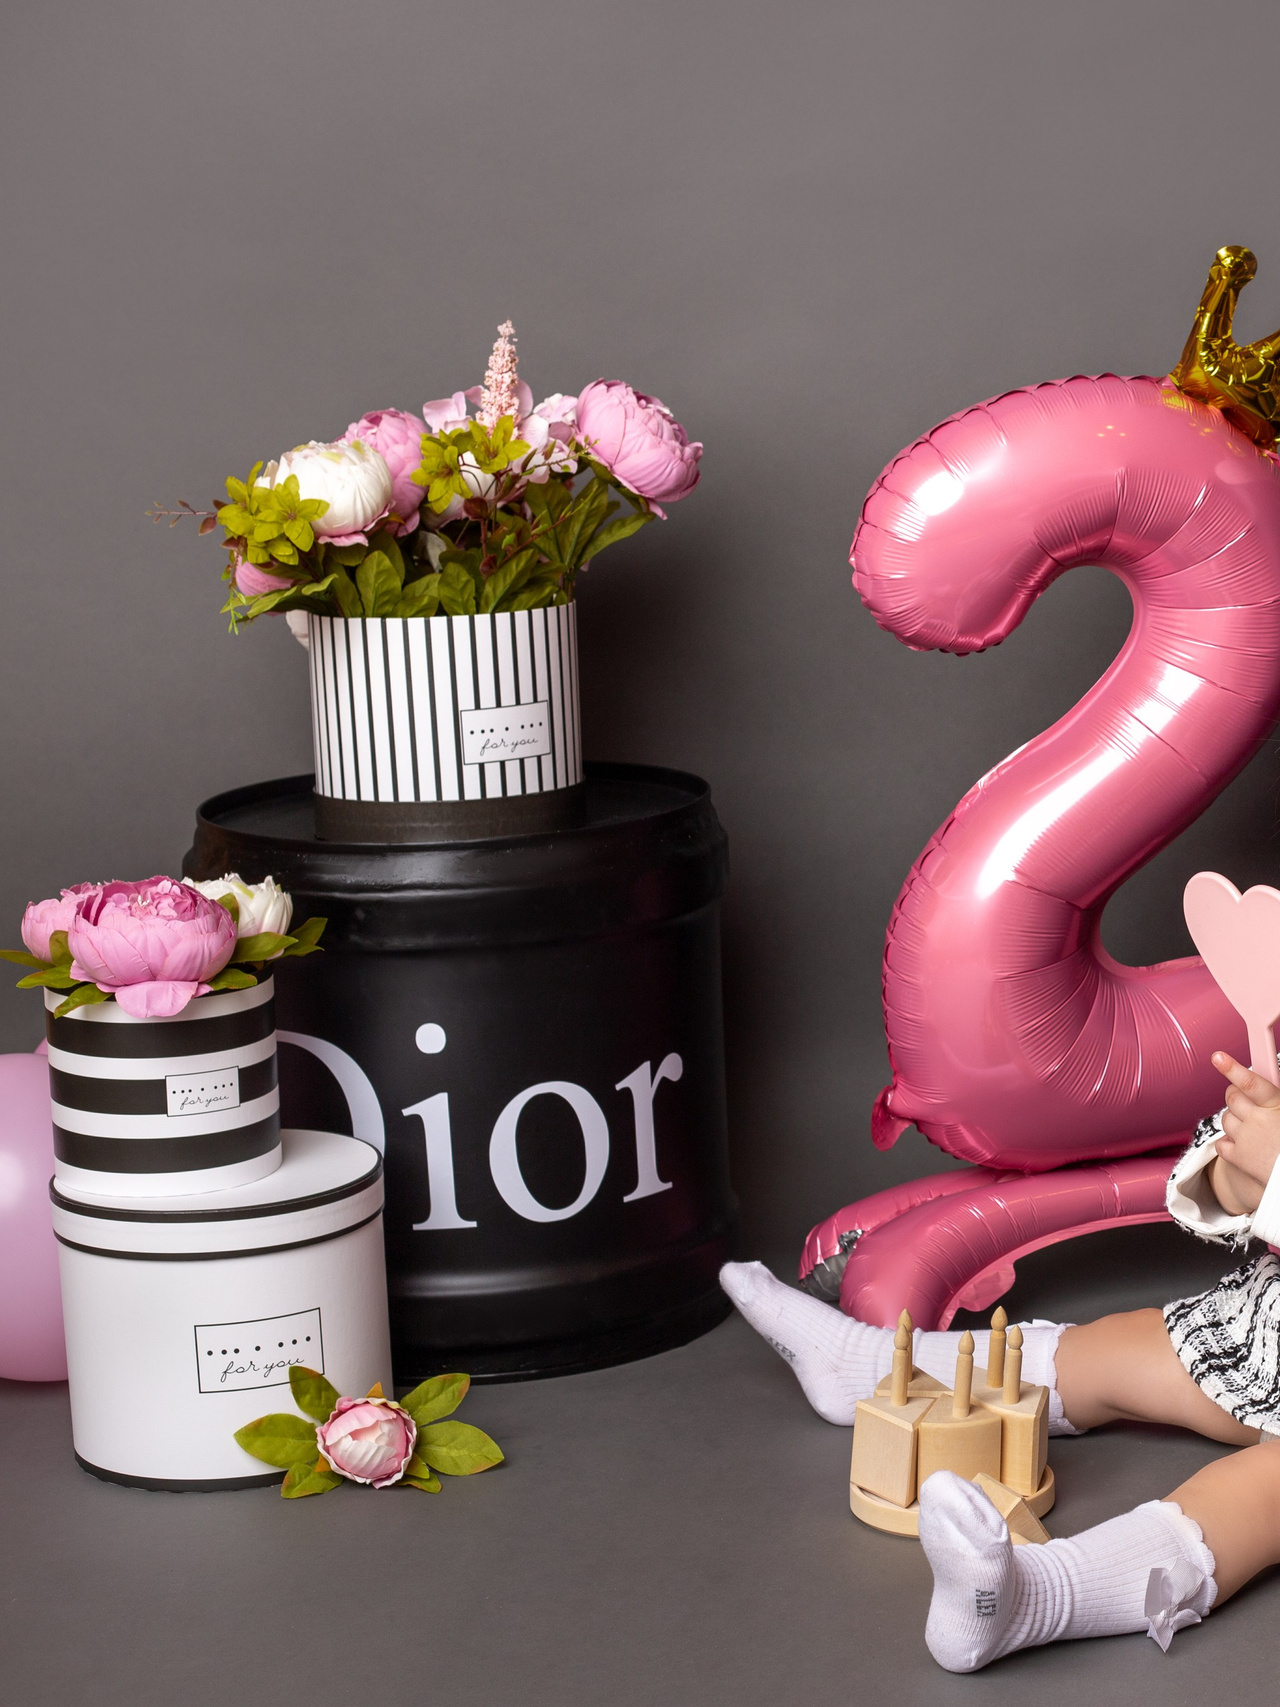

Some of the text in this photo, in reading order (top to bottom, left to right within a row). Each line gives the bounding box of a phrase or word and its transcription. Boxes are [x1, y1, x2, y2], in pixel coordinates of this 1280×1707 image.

[480, 738, 538, 757] for you
[180, 1095, 229, 1110] for you
[220, 1358, 304, 1383] for you
